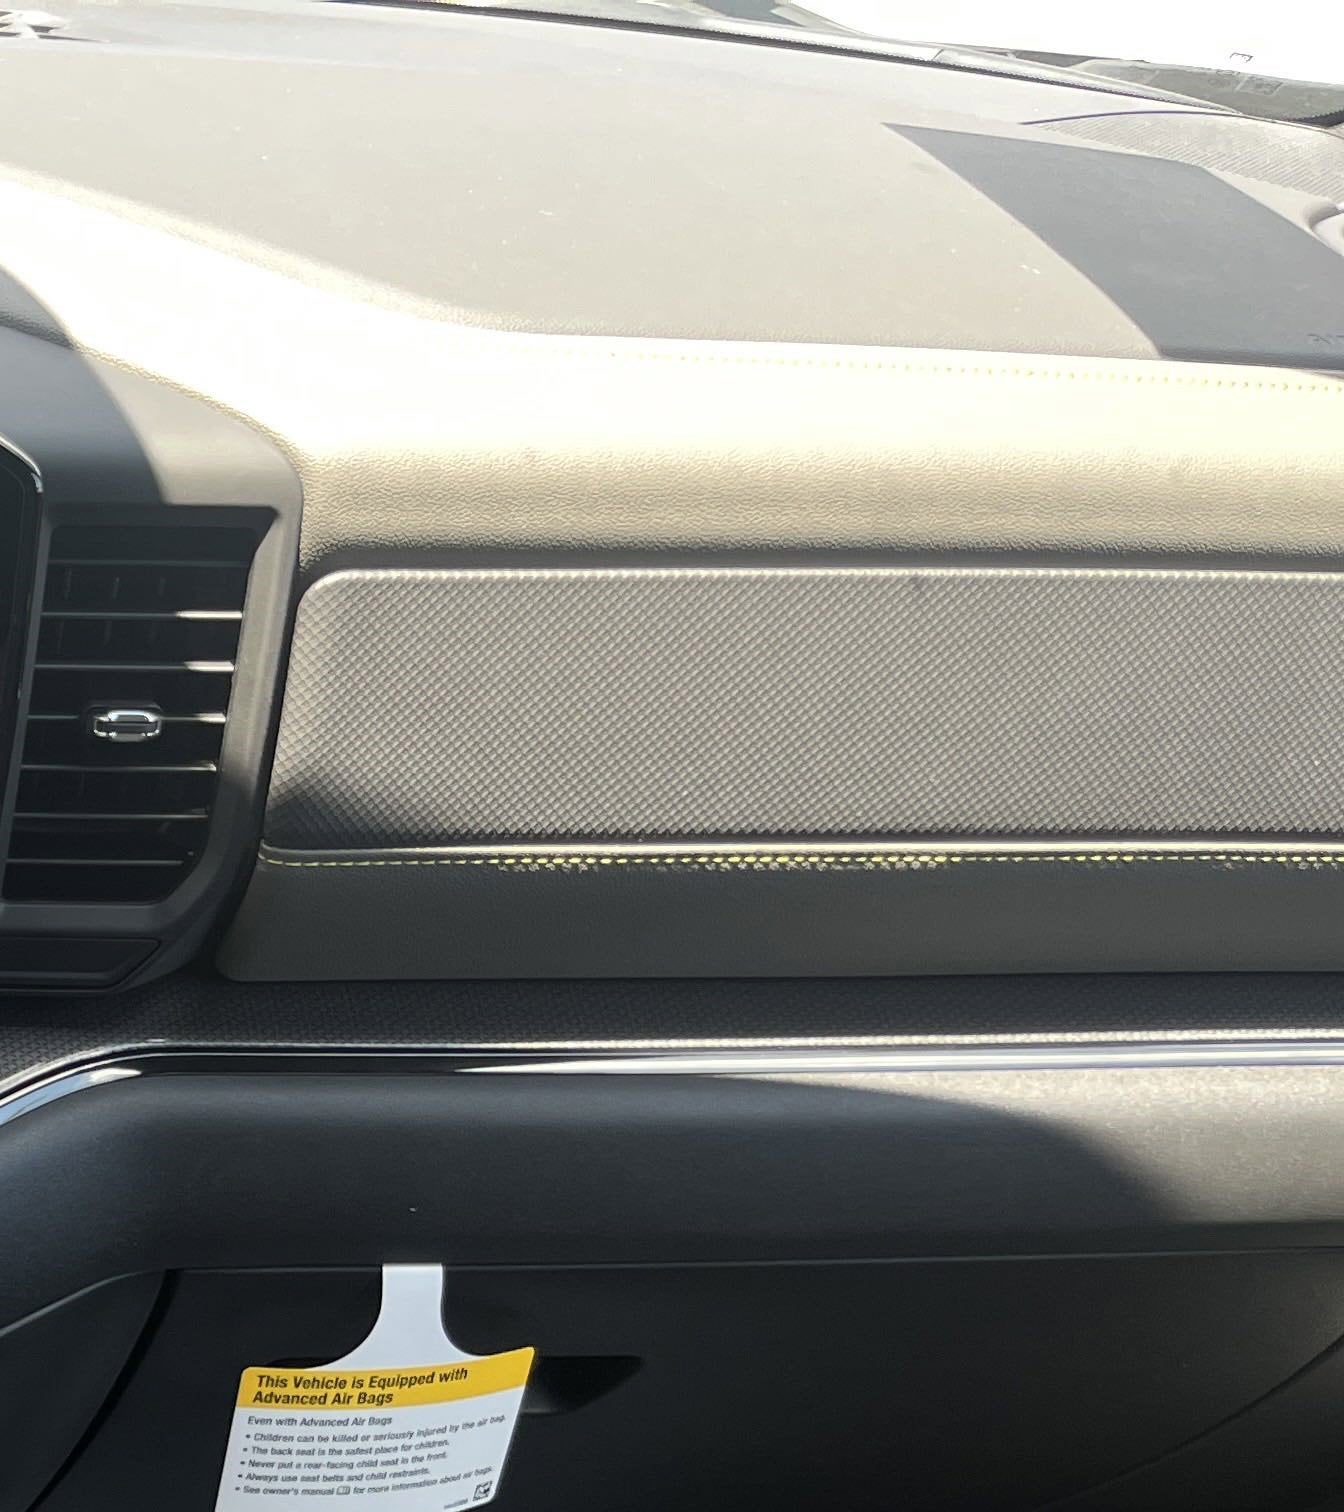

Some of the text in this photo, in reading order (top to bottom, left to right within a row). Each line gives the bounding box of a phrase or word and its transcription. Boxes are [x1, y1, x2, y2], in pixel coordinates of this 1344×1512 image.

[256, 1367, 468, 1390] This Vehicle is Equipped with
[252, 1391, 394, 1406] Advanced Air Bags
[247, 1415, 393, 1427] Even with Advanced Air Bags
[253, 1433, 295, 1443] Children
[296, 1435, 314, 1443] can
[317, 1434, 329, 1443] be
[331, 1432, 358, 1443] killed
[360, 1433, 371, 1442] or
[372, 1430, 415, 1442] seriously
[416, 1425, 447, 1438] injured
[448, 1424, 460, 1434] by
[461, 1421, 475, 1431] the
[476, 1418, 488, 1428] air
